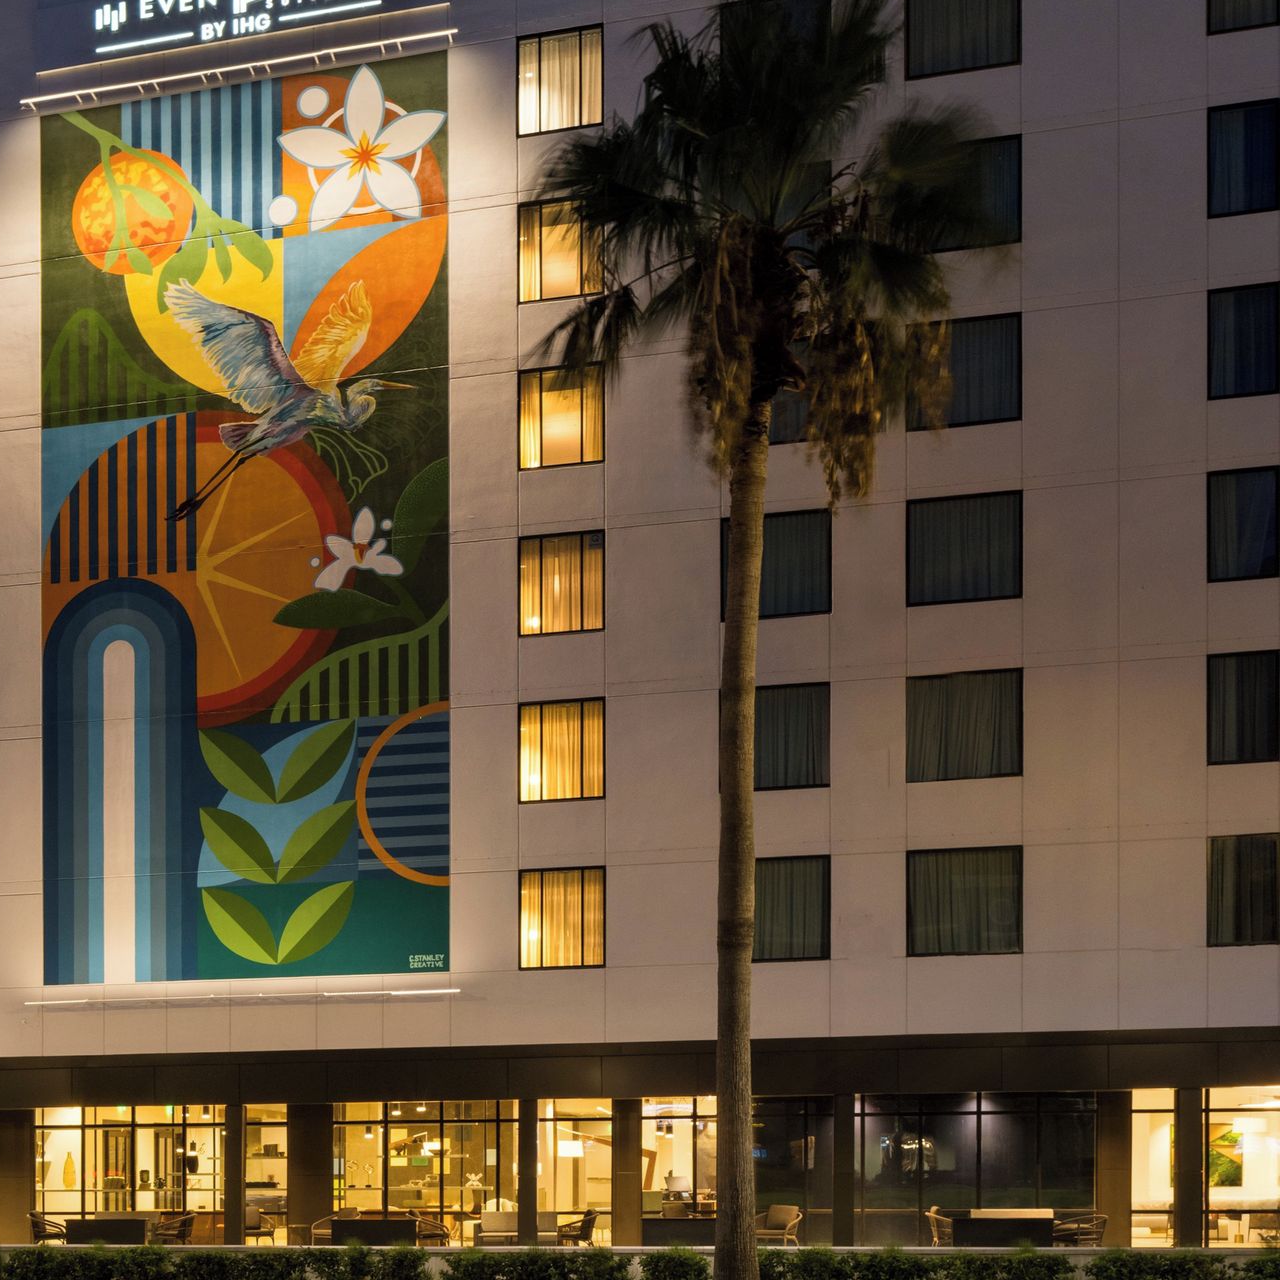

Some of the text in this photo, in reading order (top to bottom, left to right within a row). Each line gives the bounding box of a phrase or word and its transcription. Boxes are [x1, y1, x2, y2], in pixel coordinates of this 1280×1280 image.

[201, 13, 271, 41] BY IHG
[409, 961, 444, 969] CREATIVE
